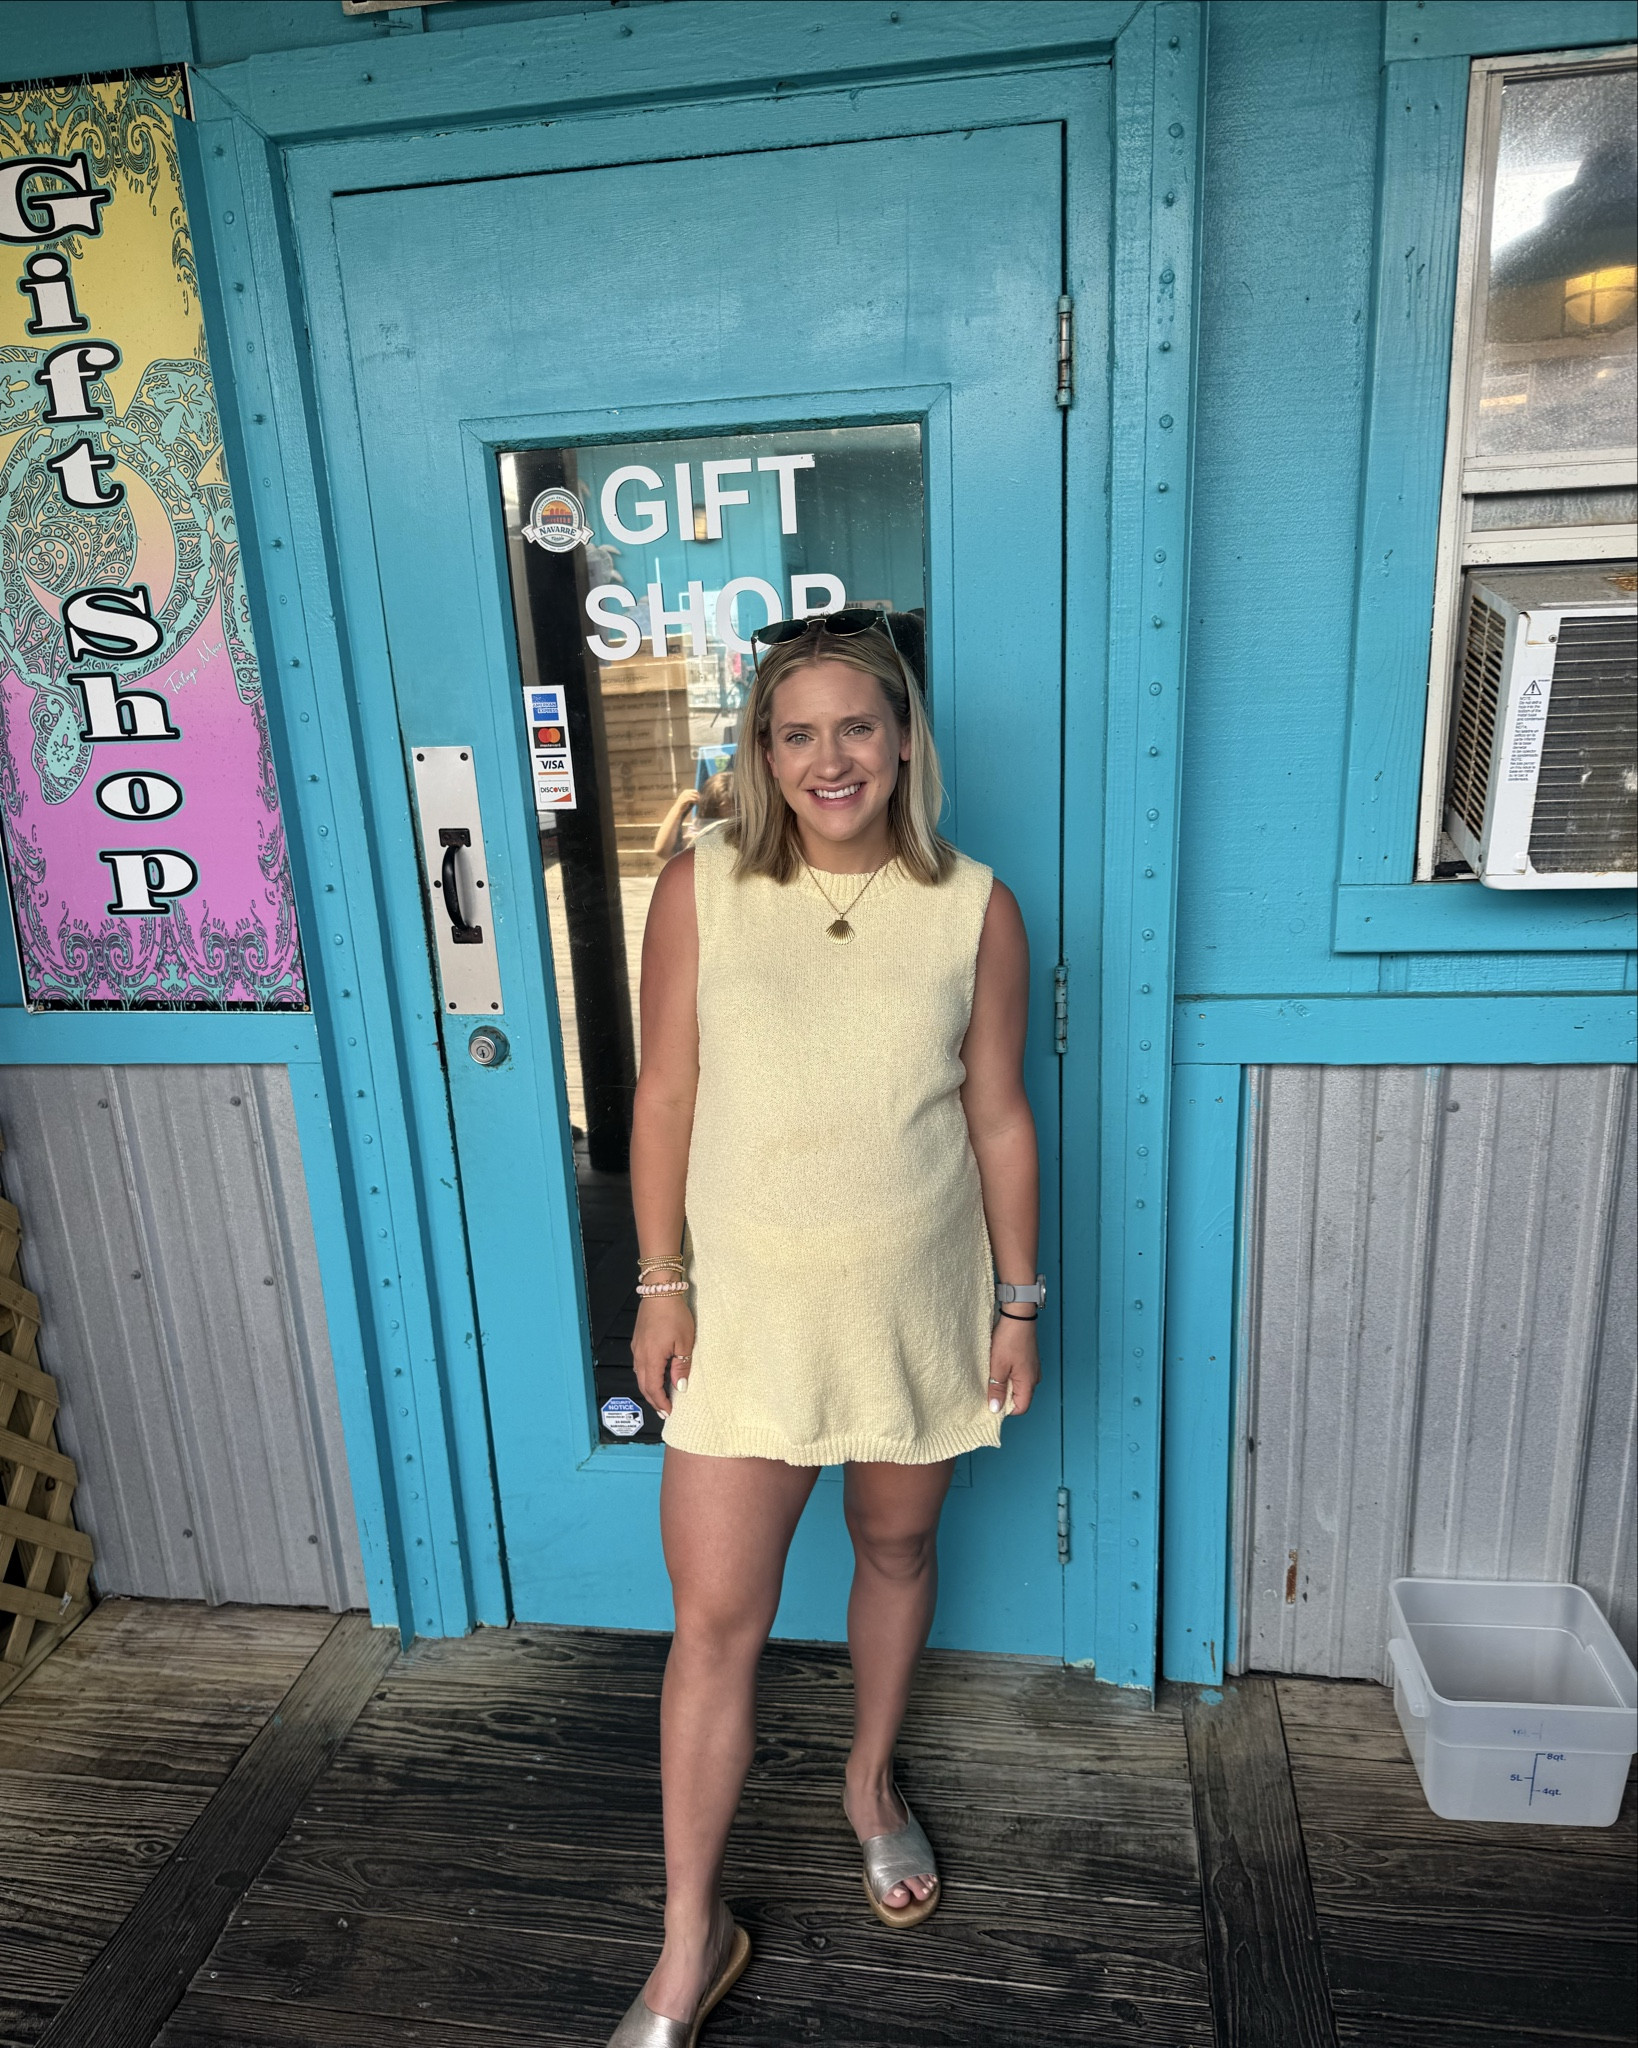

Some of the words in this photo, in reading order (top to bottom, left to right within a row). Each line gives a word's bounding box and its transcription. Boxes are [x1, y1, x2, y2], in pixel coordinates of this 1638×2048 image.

[600, 453, 816, 545] GIFT
[0, 152, 124, 510] Gift
[62, 585, 198, 916] Shop
[539, 525, 577, 537] NAVARRE
[584, 573, 847, 661] SHOP
[540, 760, 564, 769] VISA
[1547, 1752, 1566, 1762] 8qt.
[1510, 1773, 1523, 1781] 5L
[1542, 1788, 1562, 1797] 4qt.
